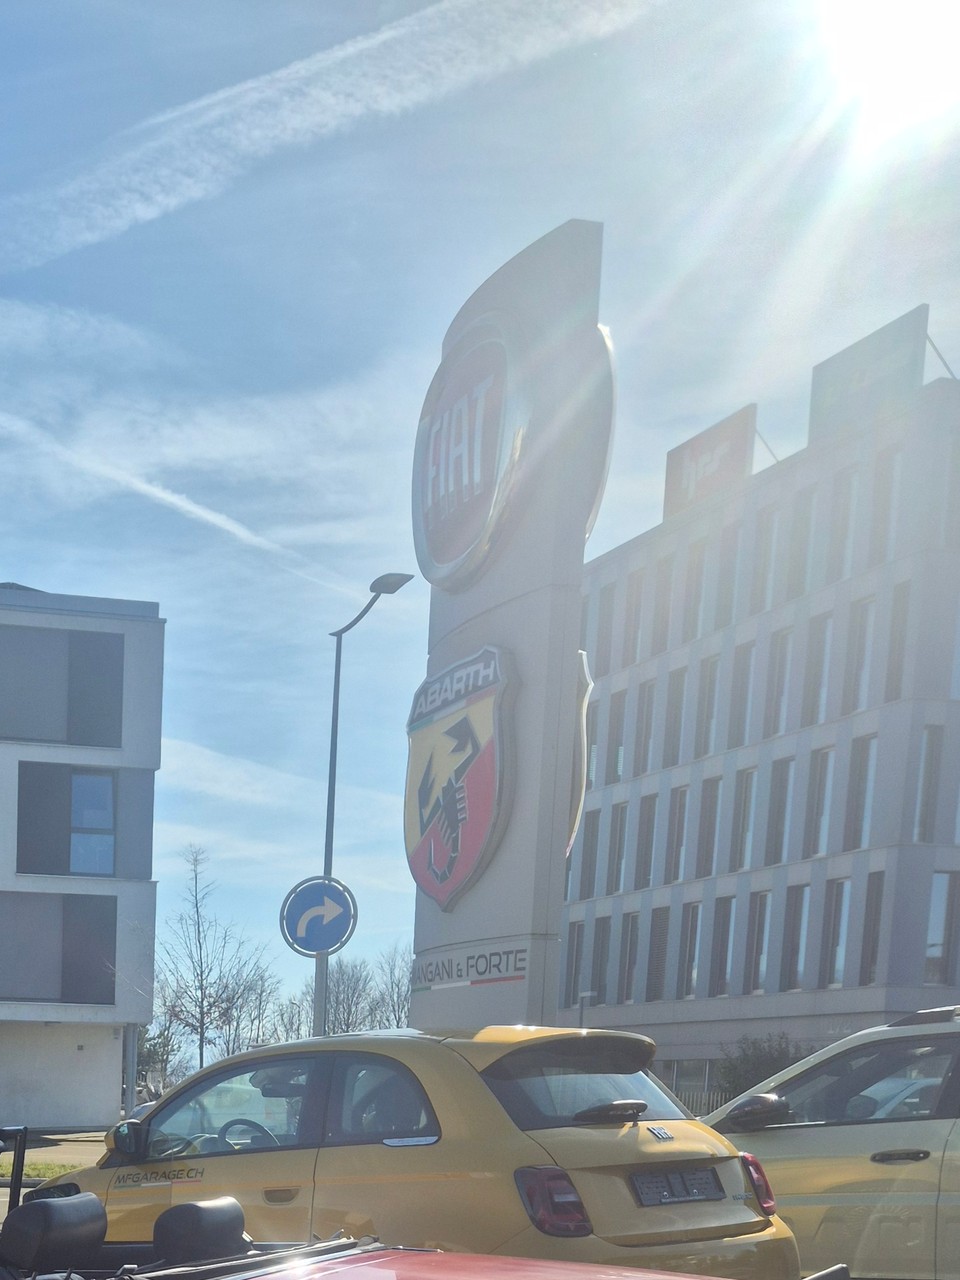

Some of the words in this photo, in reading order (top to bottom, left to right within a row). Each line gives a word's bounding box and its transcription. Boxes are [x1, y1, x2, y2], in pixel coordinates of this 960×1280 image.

[427, 374, 495, 520] FIAT
[413, 660, 495, 721] ABARTH
[456, 962, 464, 978] &
[466, 948, 528, 977] FORTE
[113, 1167, 205, 1185] MFGARAGE.CH
